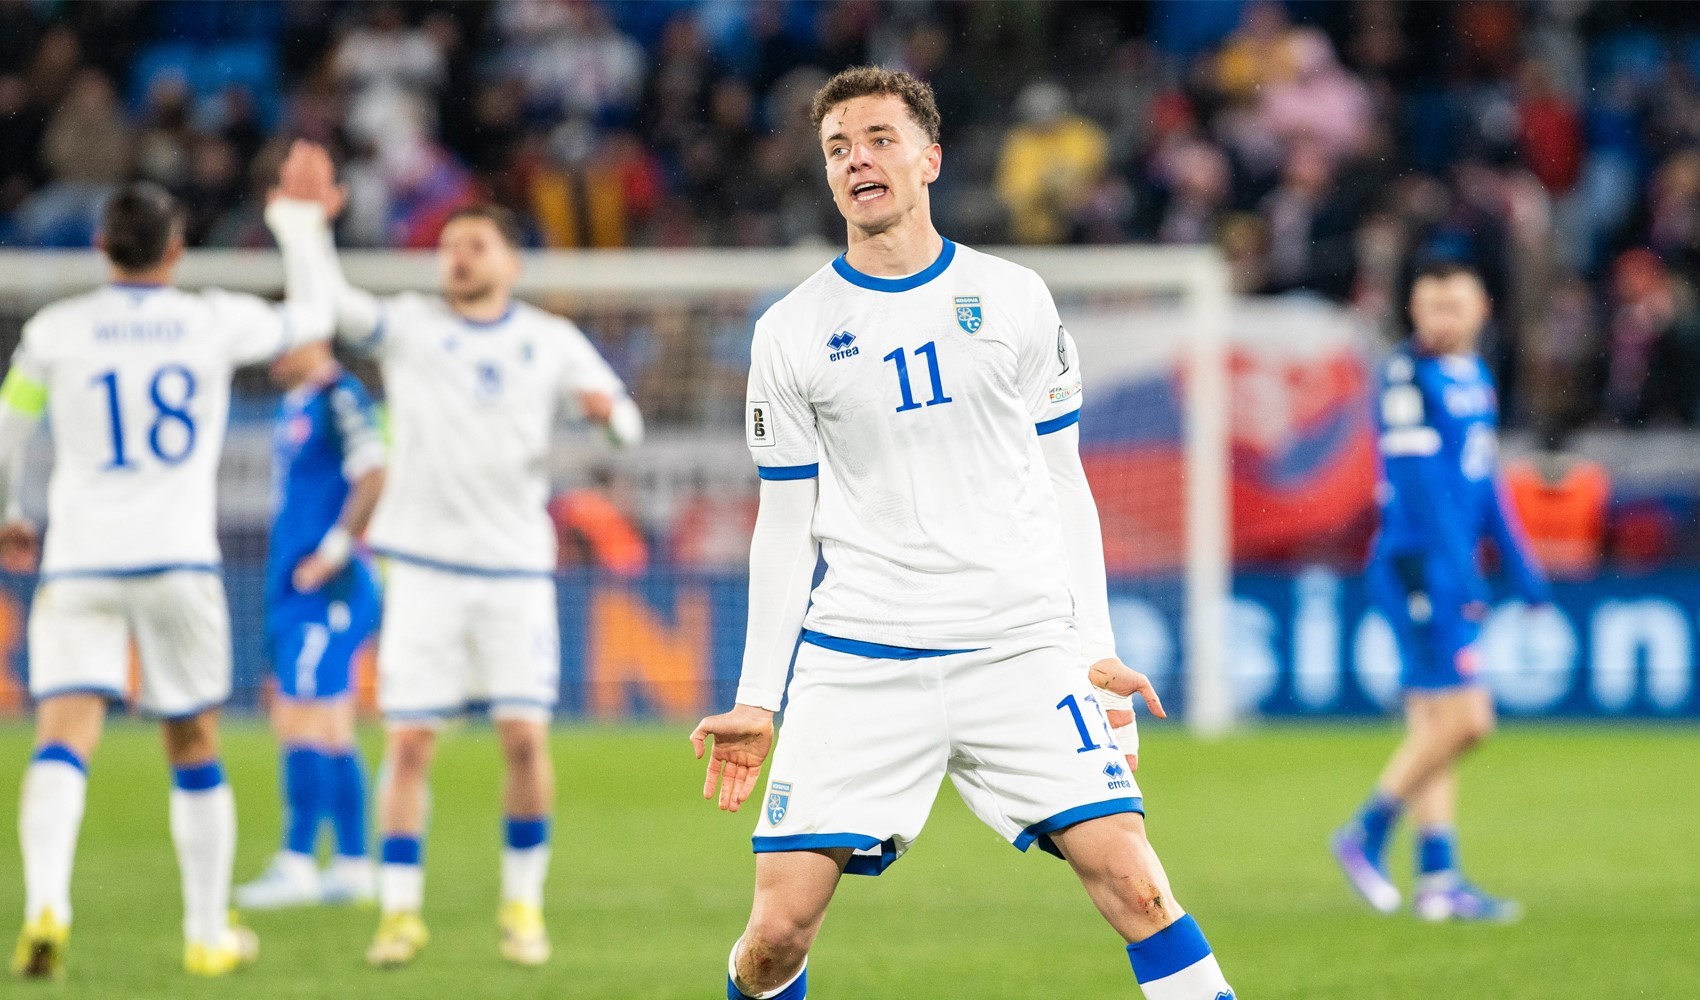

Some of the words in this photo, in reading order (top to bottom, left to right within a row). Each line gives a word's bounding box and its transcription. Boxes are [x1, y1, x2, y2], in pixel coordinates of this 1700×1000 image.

[829, 345, 860, 362] errea
[883, 341, 953, 413] 11
[88, 364, 197, 472] 18
[1056, 693, 1119, 754] 11
[1107, 780, 1131, 790] errea
